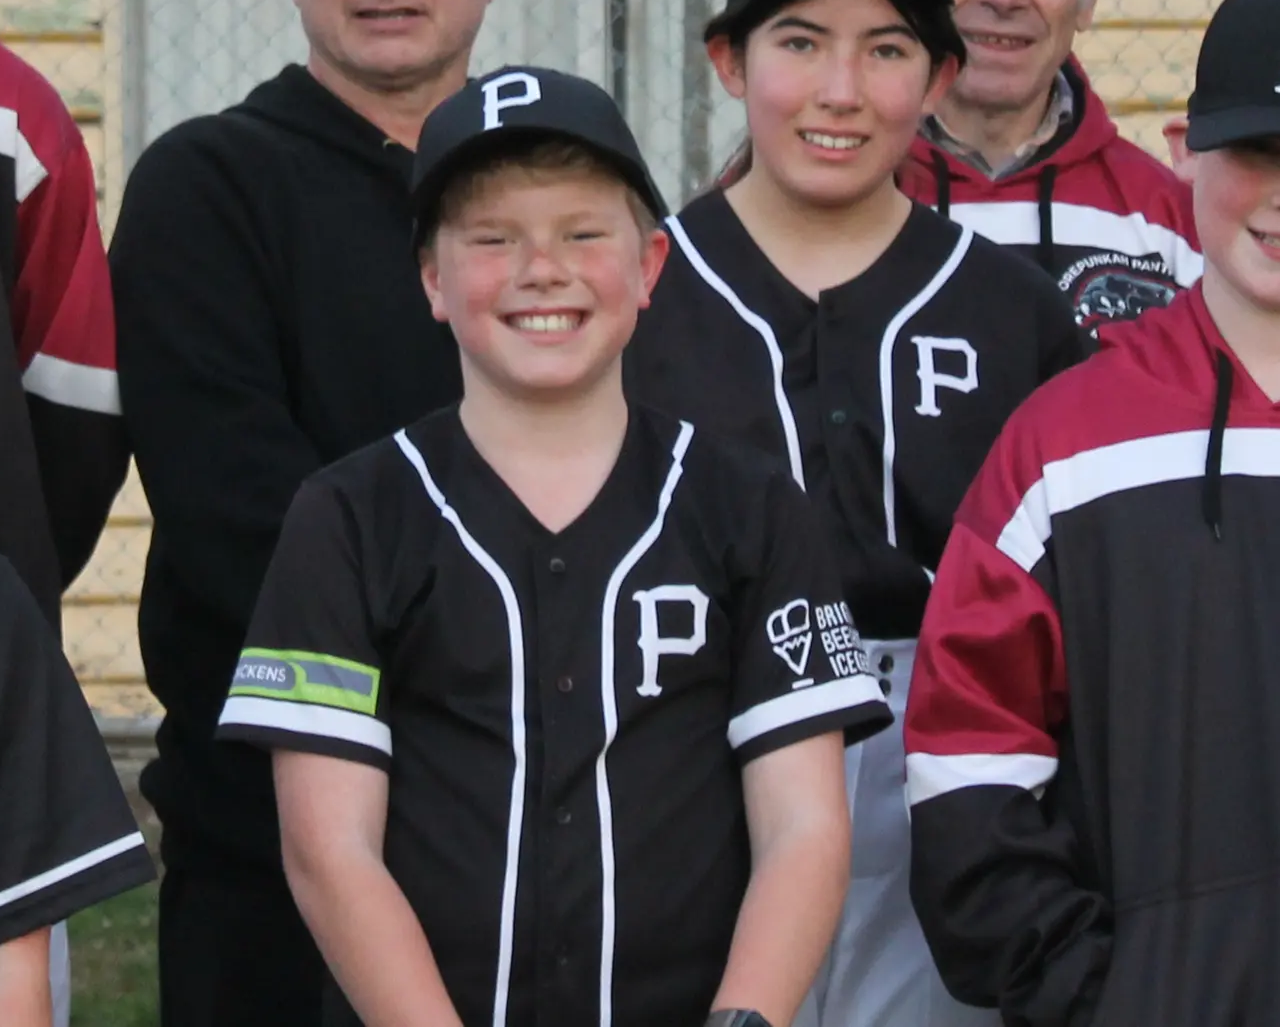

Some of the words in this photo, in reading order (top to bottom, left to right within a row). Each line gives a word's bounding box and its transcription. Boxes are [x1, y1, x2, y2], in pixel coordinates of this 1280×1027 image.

[480, 72, 541, 131] P
[1057, 253, 1129, 291] OREPUNKAH
[1131, 258, 1172, 275] PANT
[910, 335, 979, 417] P
[632, 584, 710, 697] P
[820, 625, 859, 654] BEE
[238, 663, 287, 682] CKENS
